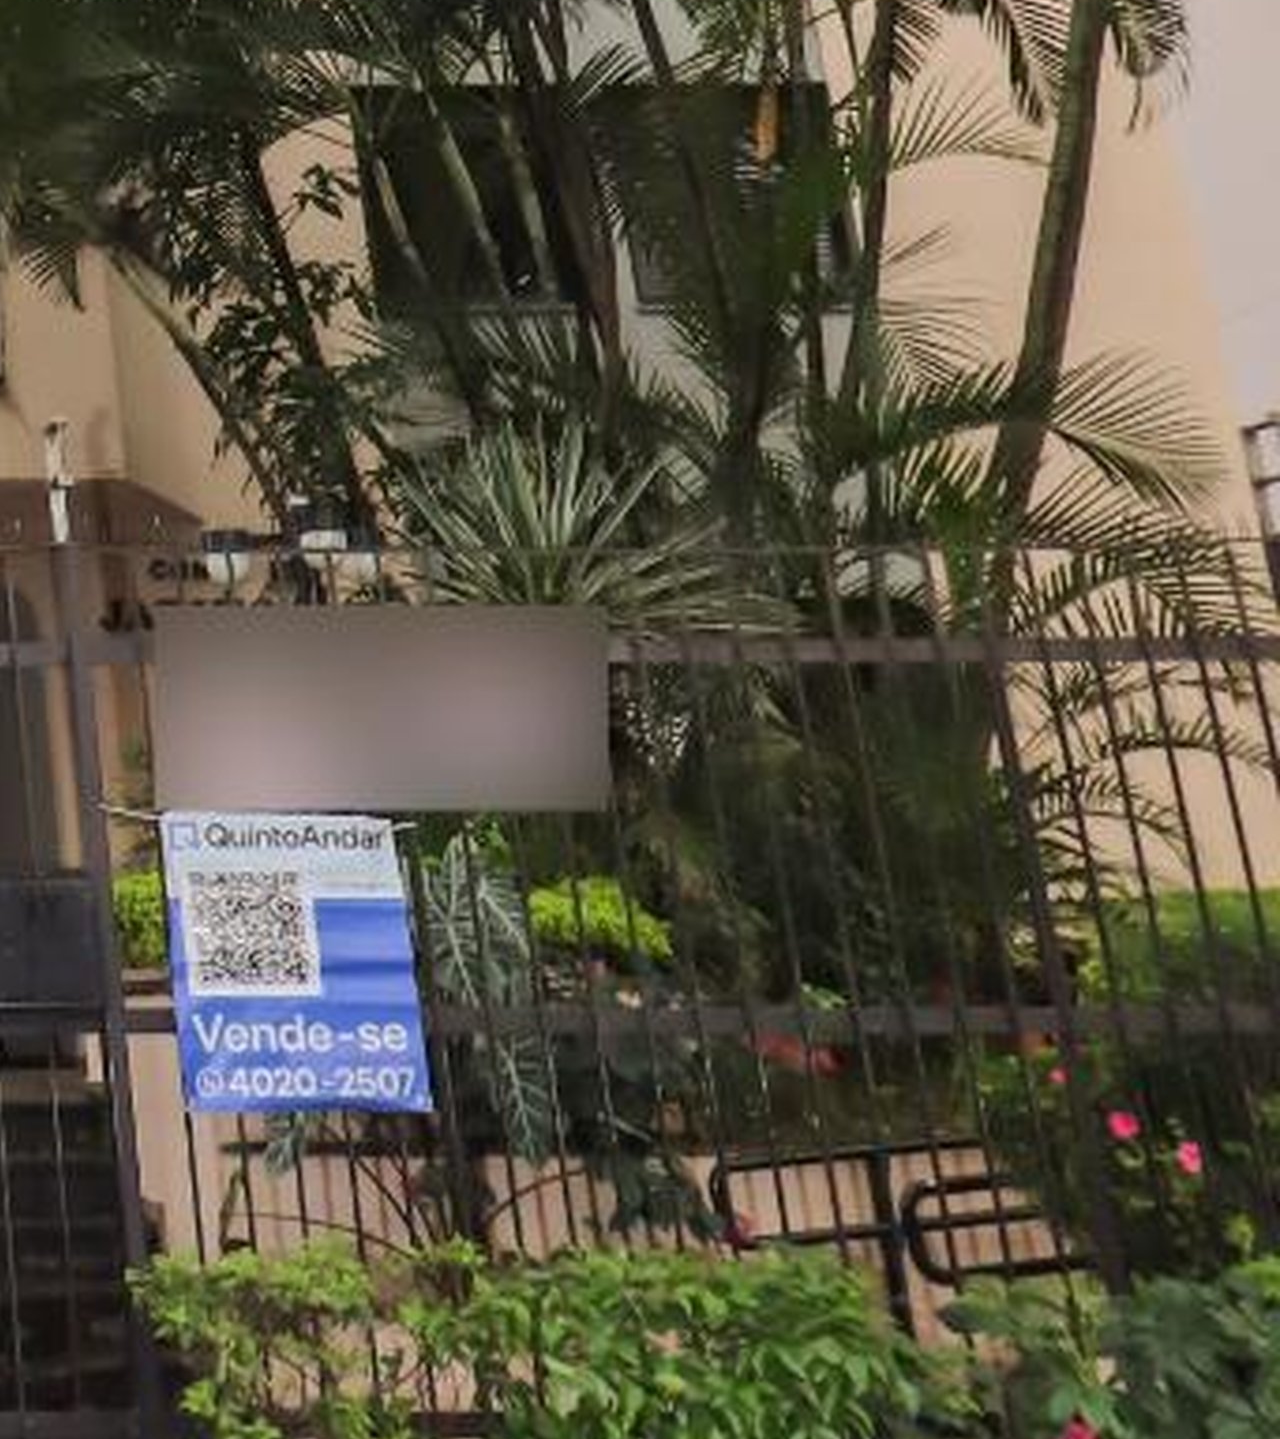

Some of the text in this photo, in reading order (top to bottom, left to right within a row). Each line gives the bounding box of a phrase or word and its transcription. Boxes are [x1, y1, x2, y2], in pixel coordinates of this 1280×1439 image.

[204, 823, 383, 850] QuintoAndar
[192, 1013, 408, 1053] Vende-se
[228, 1067, 416, 1098] 4020-2507
